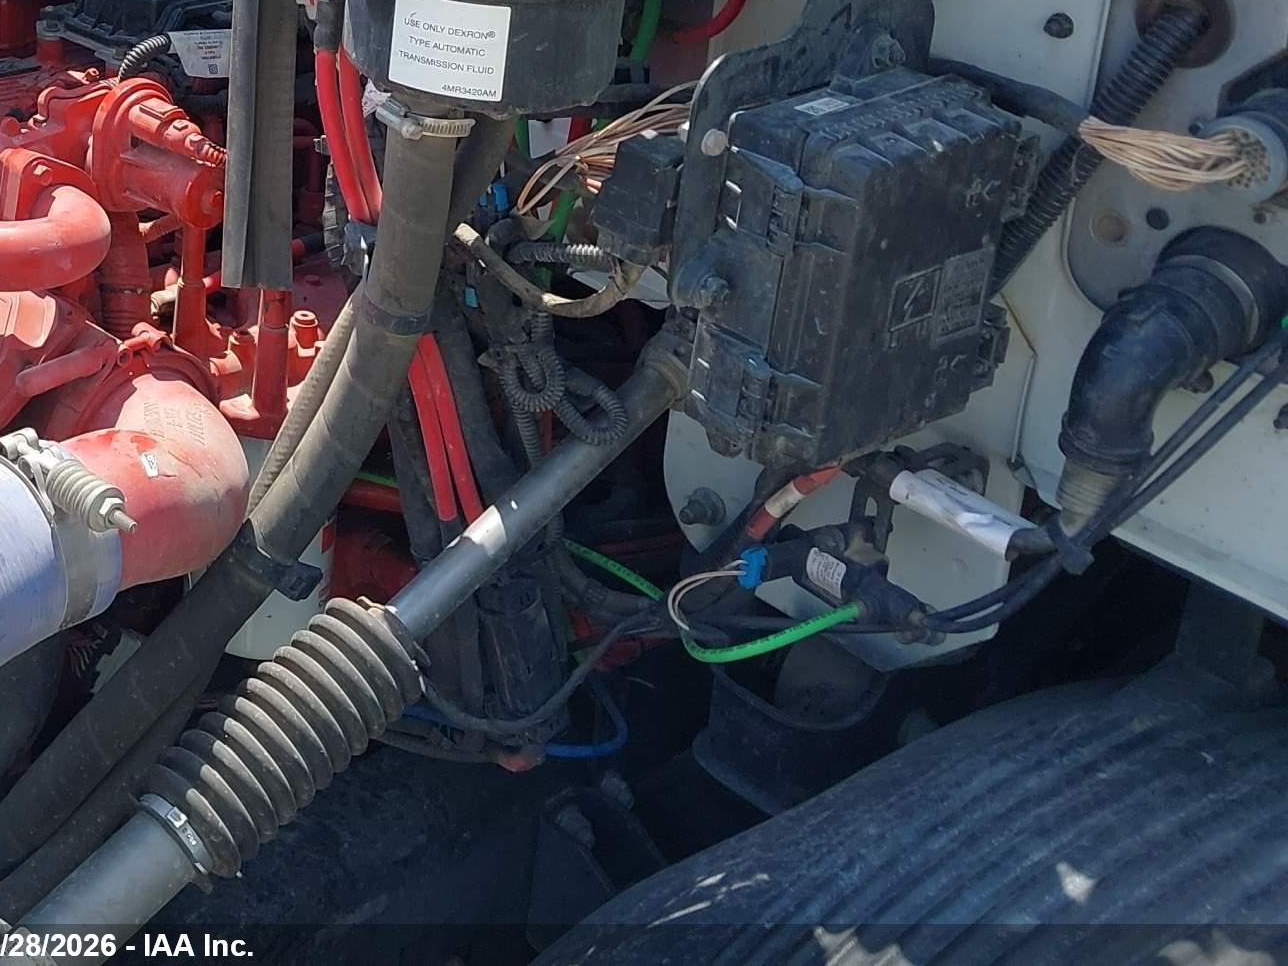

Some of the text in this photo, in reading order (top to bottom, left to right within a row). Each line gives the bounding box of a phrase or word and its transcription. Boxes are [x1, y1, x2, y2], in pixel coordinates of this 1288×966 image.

[404, 17, 421, 29] USE
[423, 22, 446, 34] ONLY
[409, 35, 486, 57] TYPE AUTOMATIC
[399, 50, 495, 75] TRANSMISSION FLUID
[442, 84, 497, 98] 4MR3420AM
